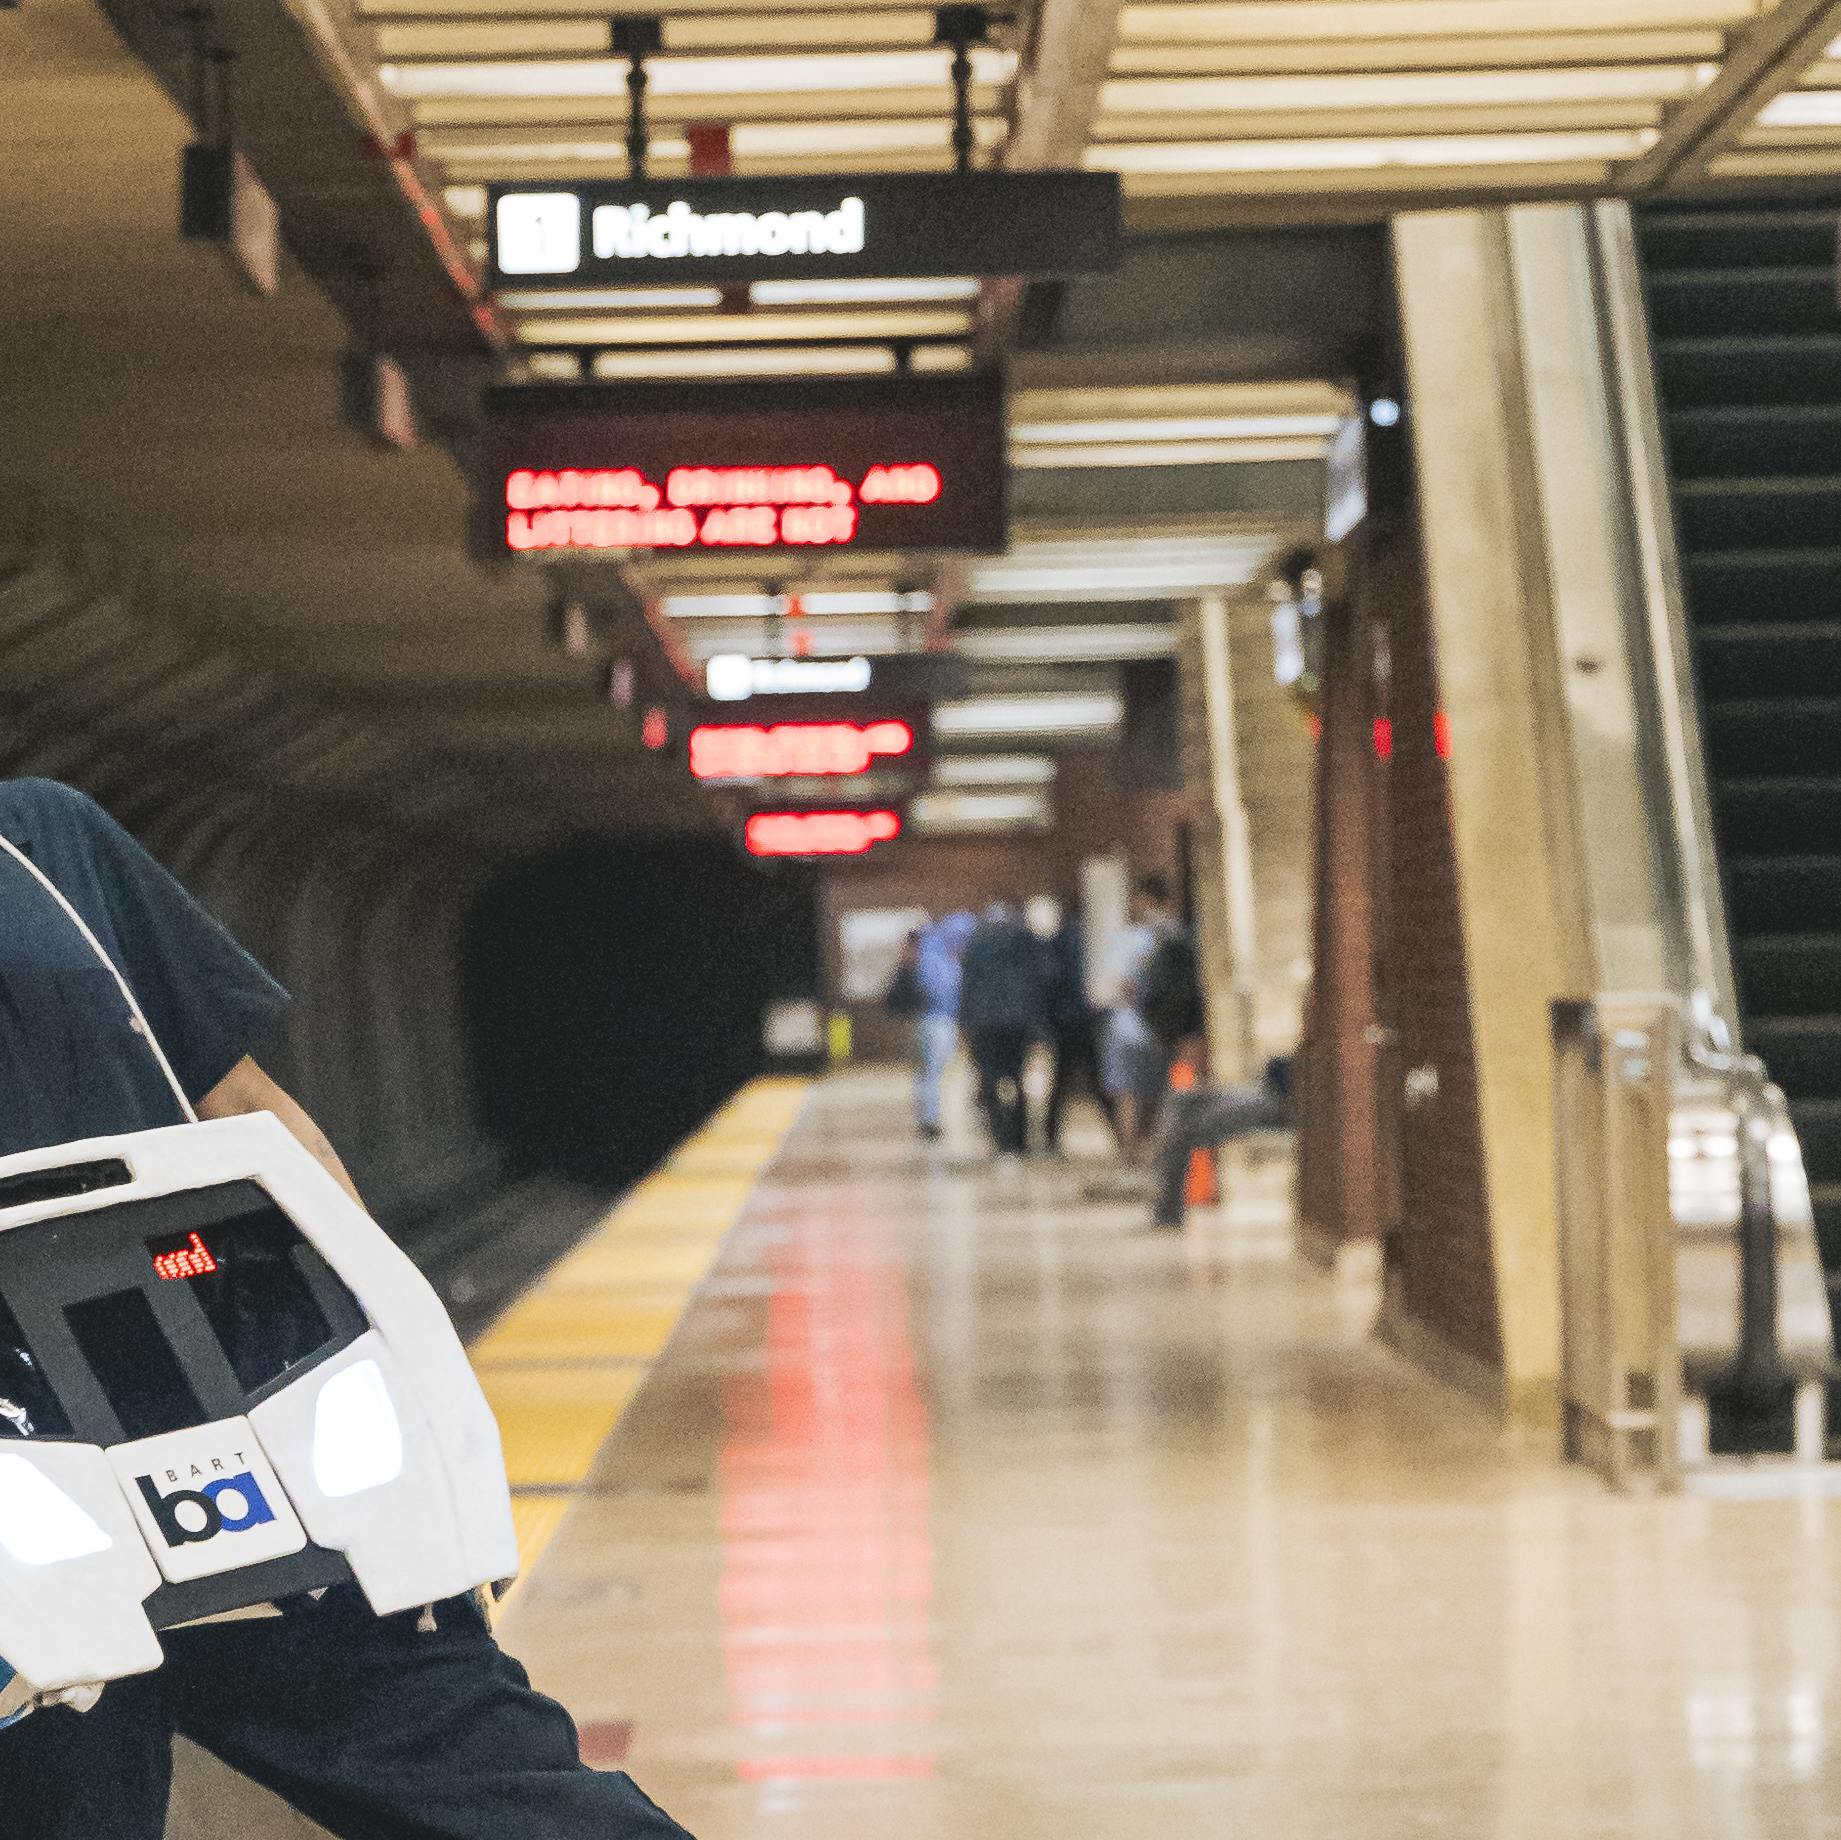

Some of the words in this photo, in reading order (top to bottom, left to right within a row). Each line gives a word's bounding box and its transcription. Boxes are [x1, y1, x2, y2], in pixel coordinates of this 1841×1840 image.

[592, 196, 865, 258] Richmond
[166, 1451, 246, 1483] BART
[134, 1470, 278, 1549] ba
